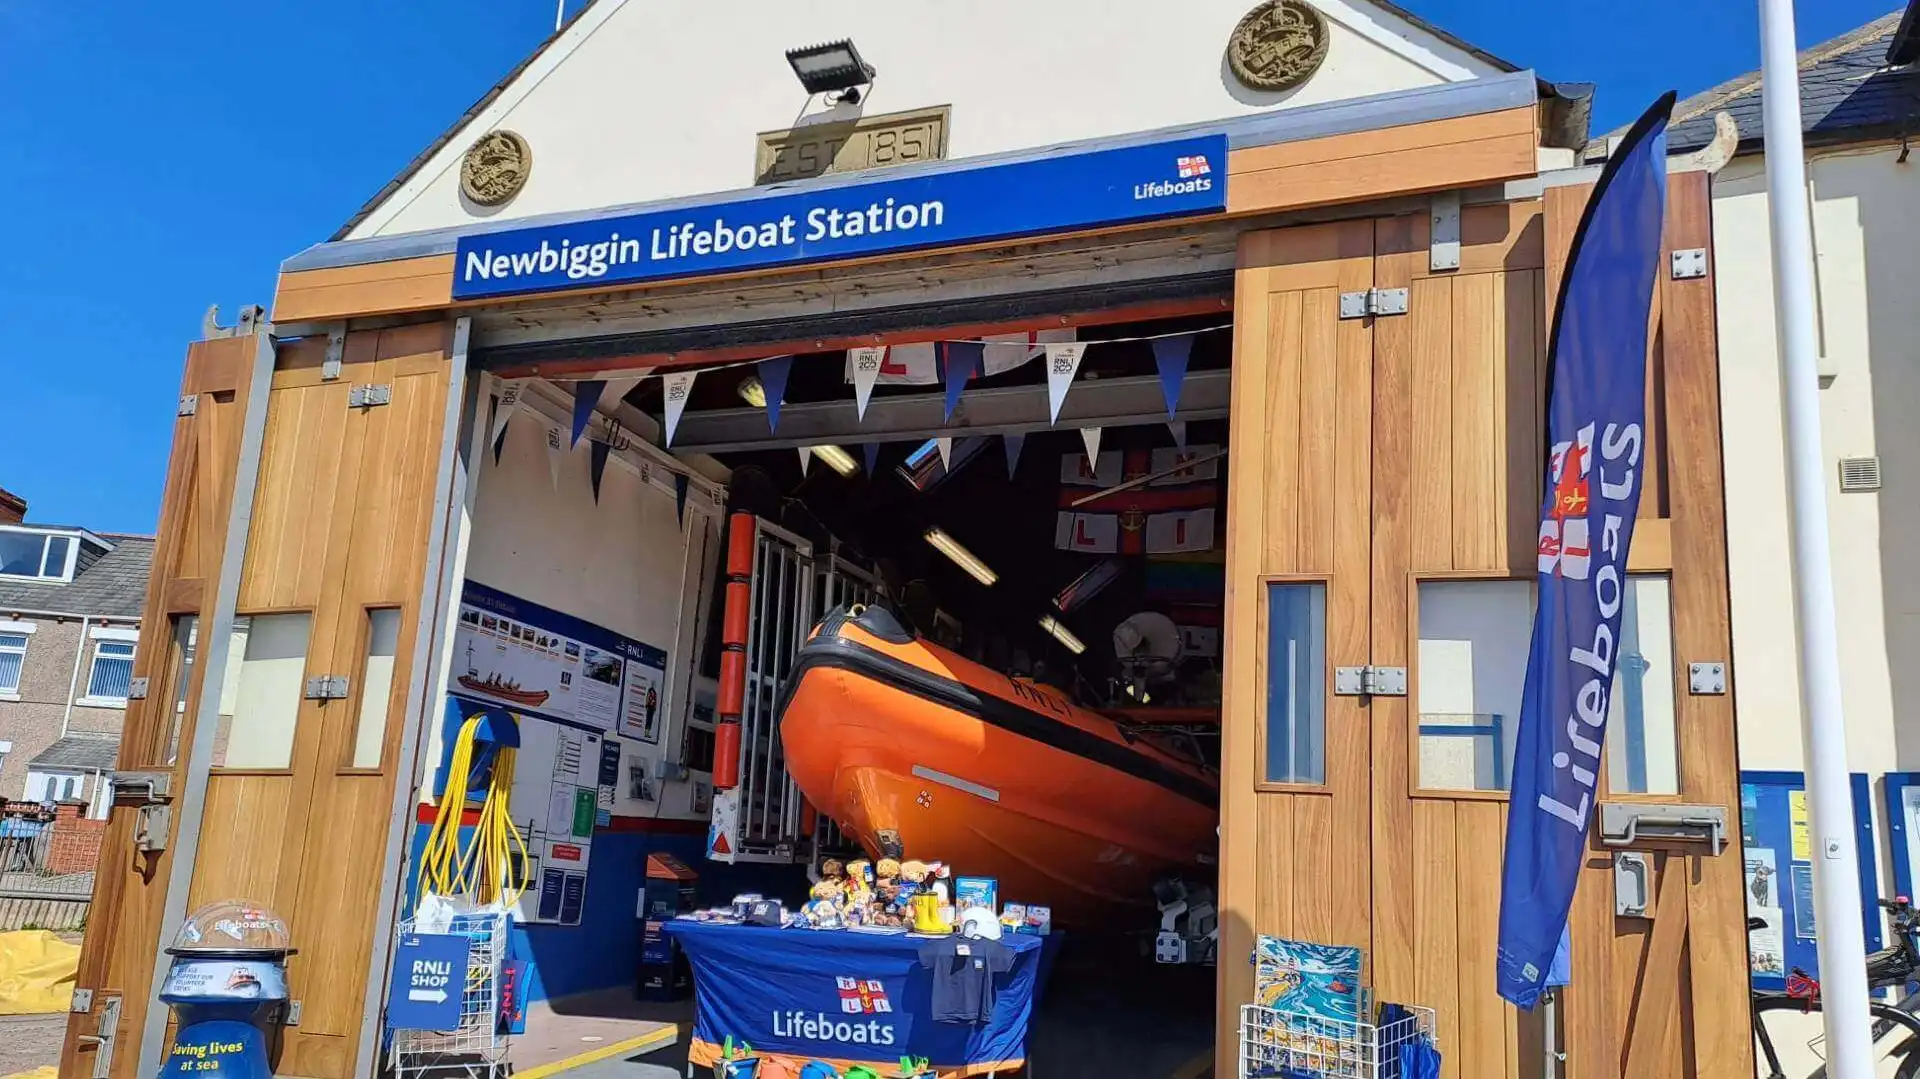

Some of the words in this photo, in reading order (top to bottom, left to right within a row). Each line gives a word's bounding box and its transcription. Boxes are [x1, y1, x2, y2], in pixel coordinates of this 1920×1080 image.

[774, 138, 845, 178] EST
[866, 124, 933, 168] 1851
[1134, 178, 1212, 200] Lifeboats
[464, 233, 640, 282] Newbiggin
[651, 214, 796, 260] Lifeboat
[805, 197, 944, 241] Station
[1537, 421, 1642, 833] Lifeboats
[627, 644, 643, 659] RNLI
[1010, 678, 1072, 718] RNLI
[412, 959, 451, 975] RNLI
[410, 974, 449, 987] SHOP
[773, 1009, 895, 1045] Lifeboats
[209, 1041, 243, 1055] lives
[180, 1060, 194, 1071] at
[196, 1060, 219, 1071] sea
